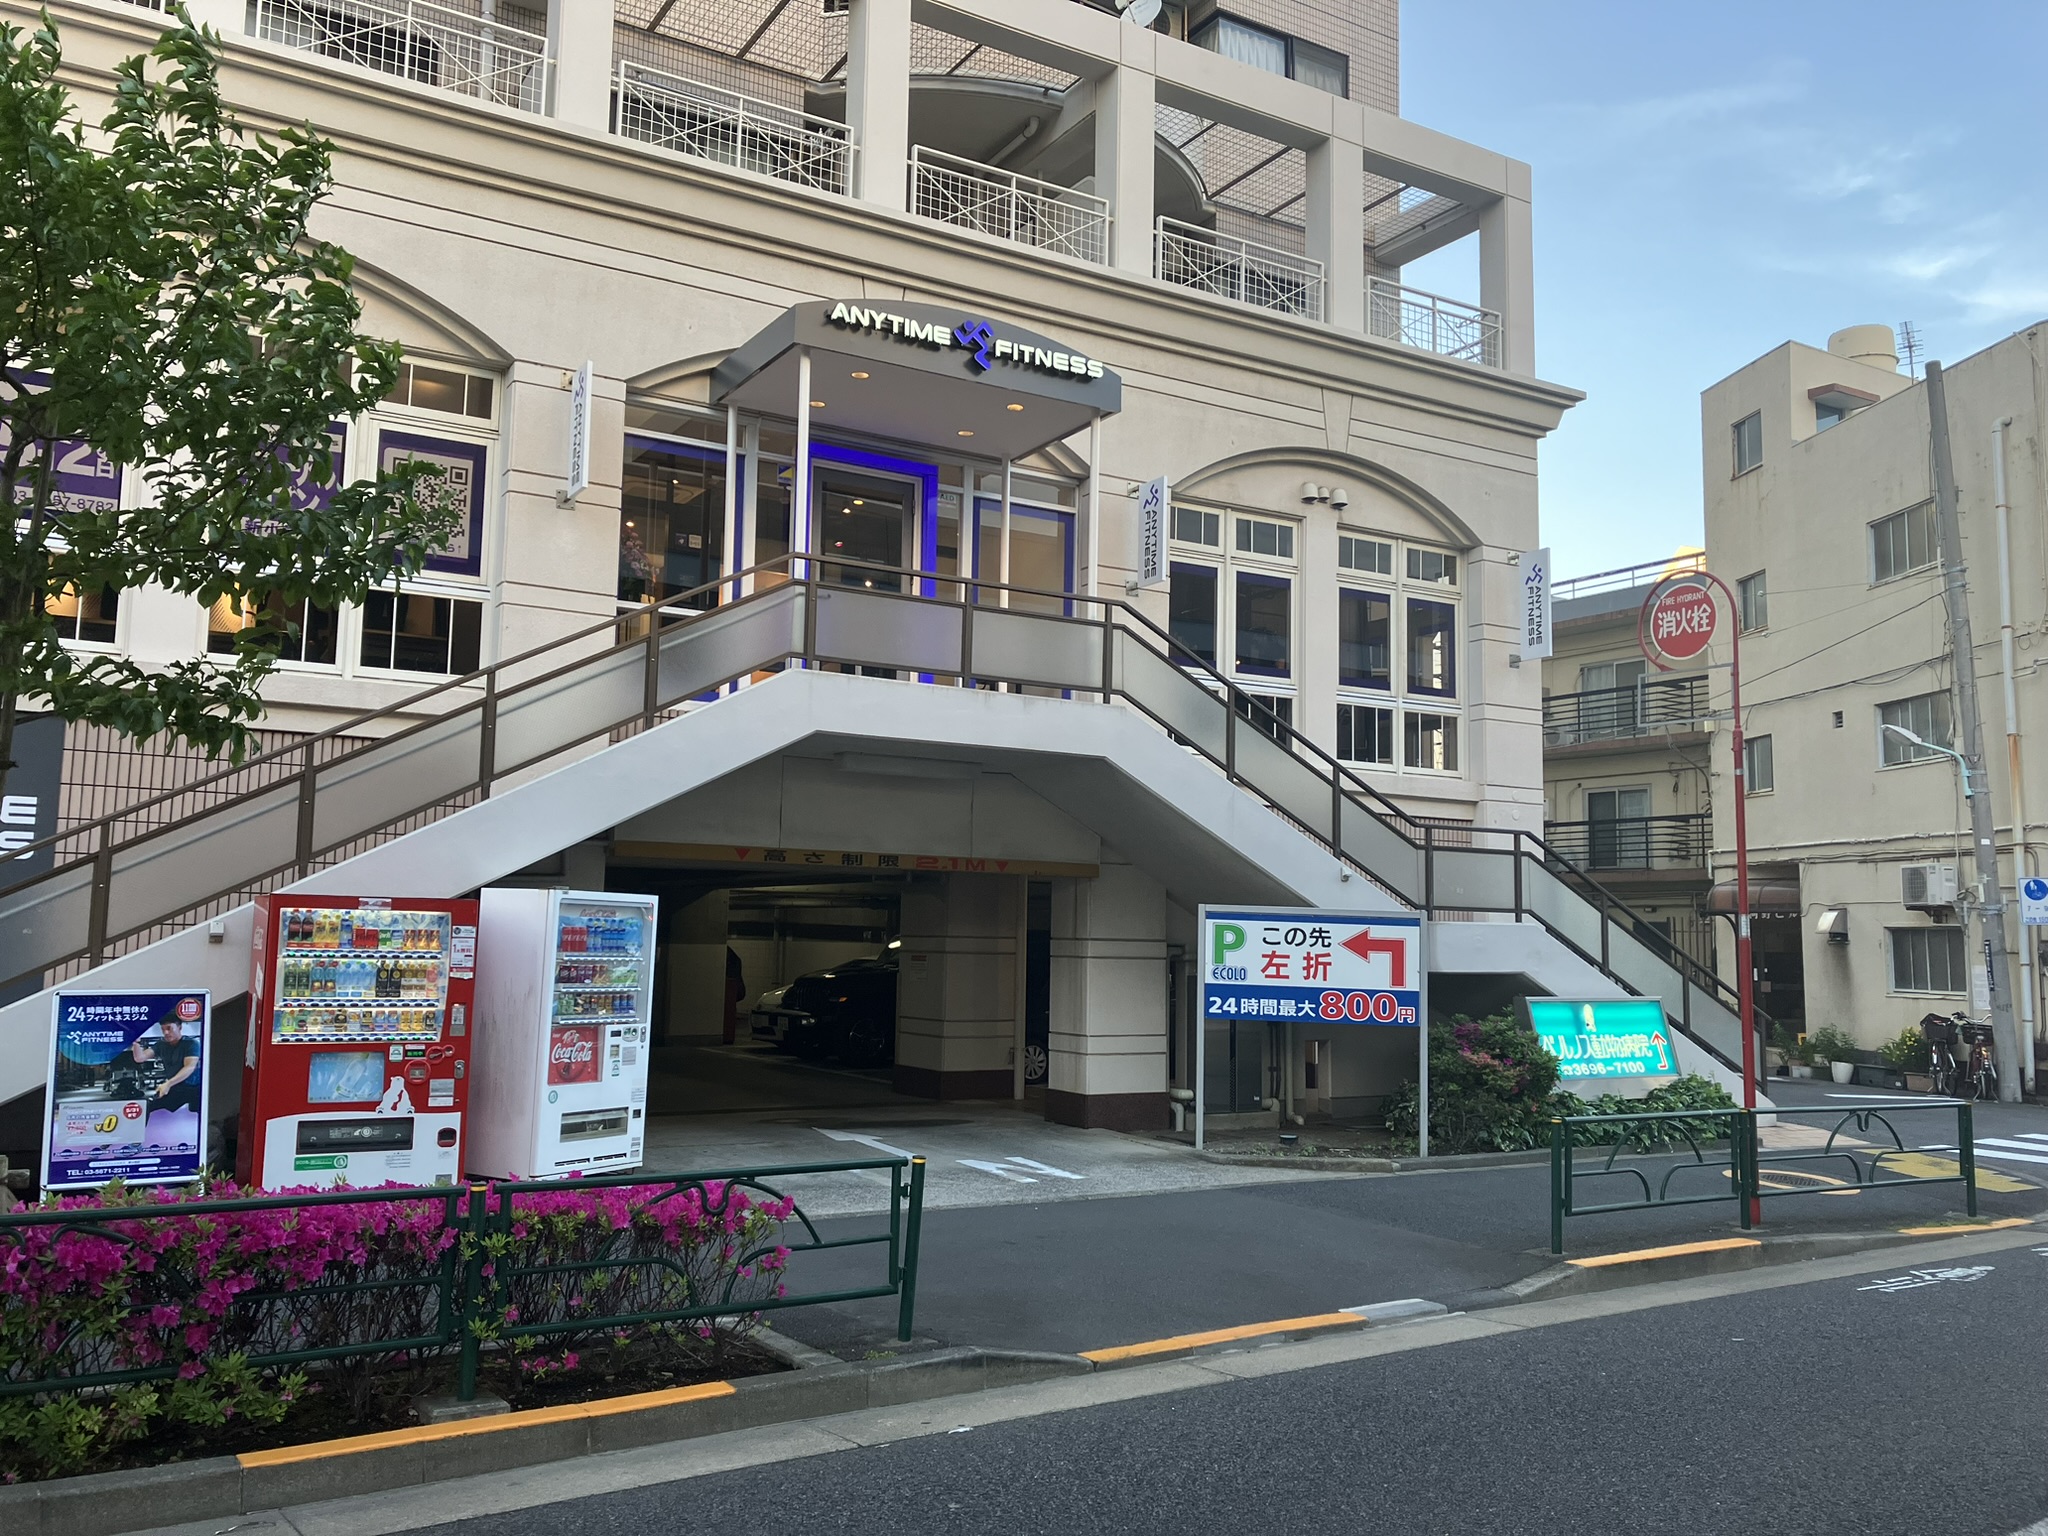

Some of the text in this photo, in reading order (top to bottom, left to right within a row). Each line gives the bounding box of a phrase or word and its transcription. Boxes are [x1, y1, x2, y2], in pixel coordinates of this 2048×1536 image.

[830, 302, 1104, 379] ANYTIME FITNESS
[1662, 591, 1705, 606] FIRE HYDRANT
[1535, 585, 1543, 645] ANYTIME
[1657, 603, 1712, 639] 消火栓
[764, 849, 987, 872] 高さ制限 2.1M
[1213, 923, 1246, 965] P
[1262, 927, 1332, 948] この先
[1212, 966, 1246, 981] ECOLO
[1261, 950, 1332, 981] 左折
[67, 1006, 149, 1022] 24 時間年中無休の
[86, 1014, 149, 1022] フィットネスジム
[1574, 1061, 1646, 1076] 3696-7100
